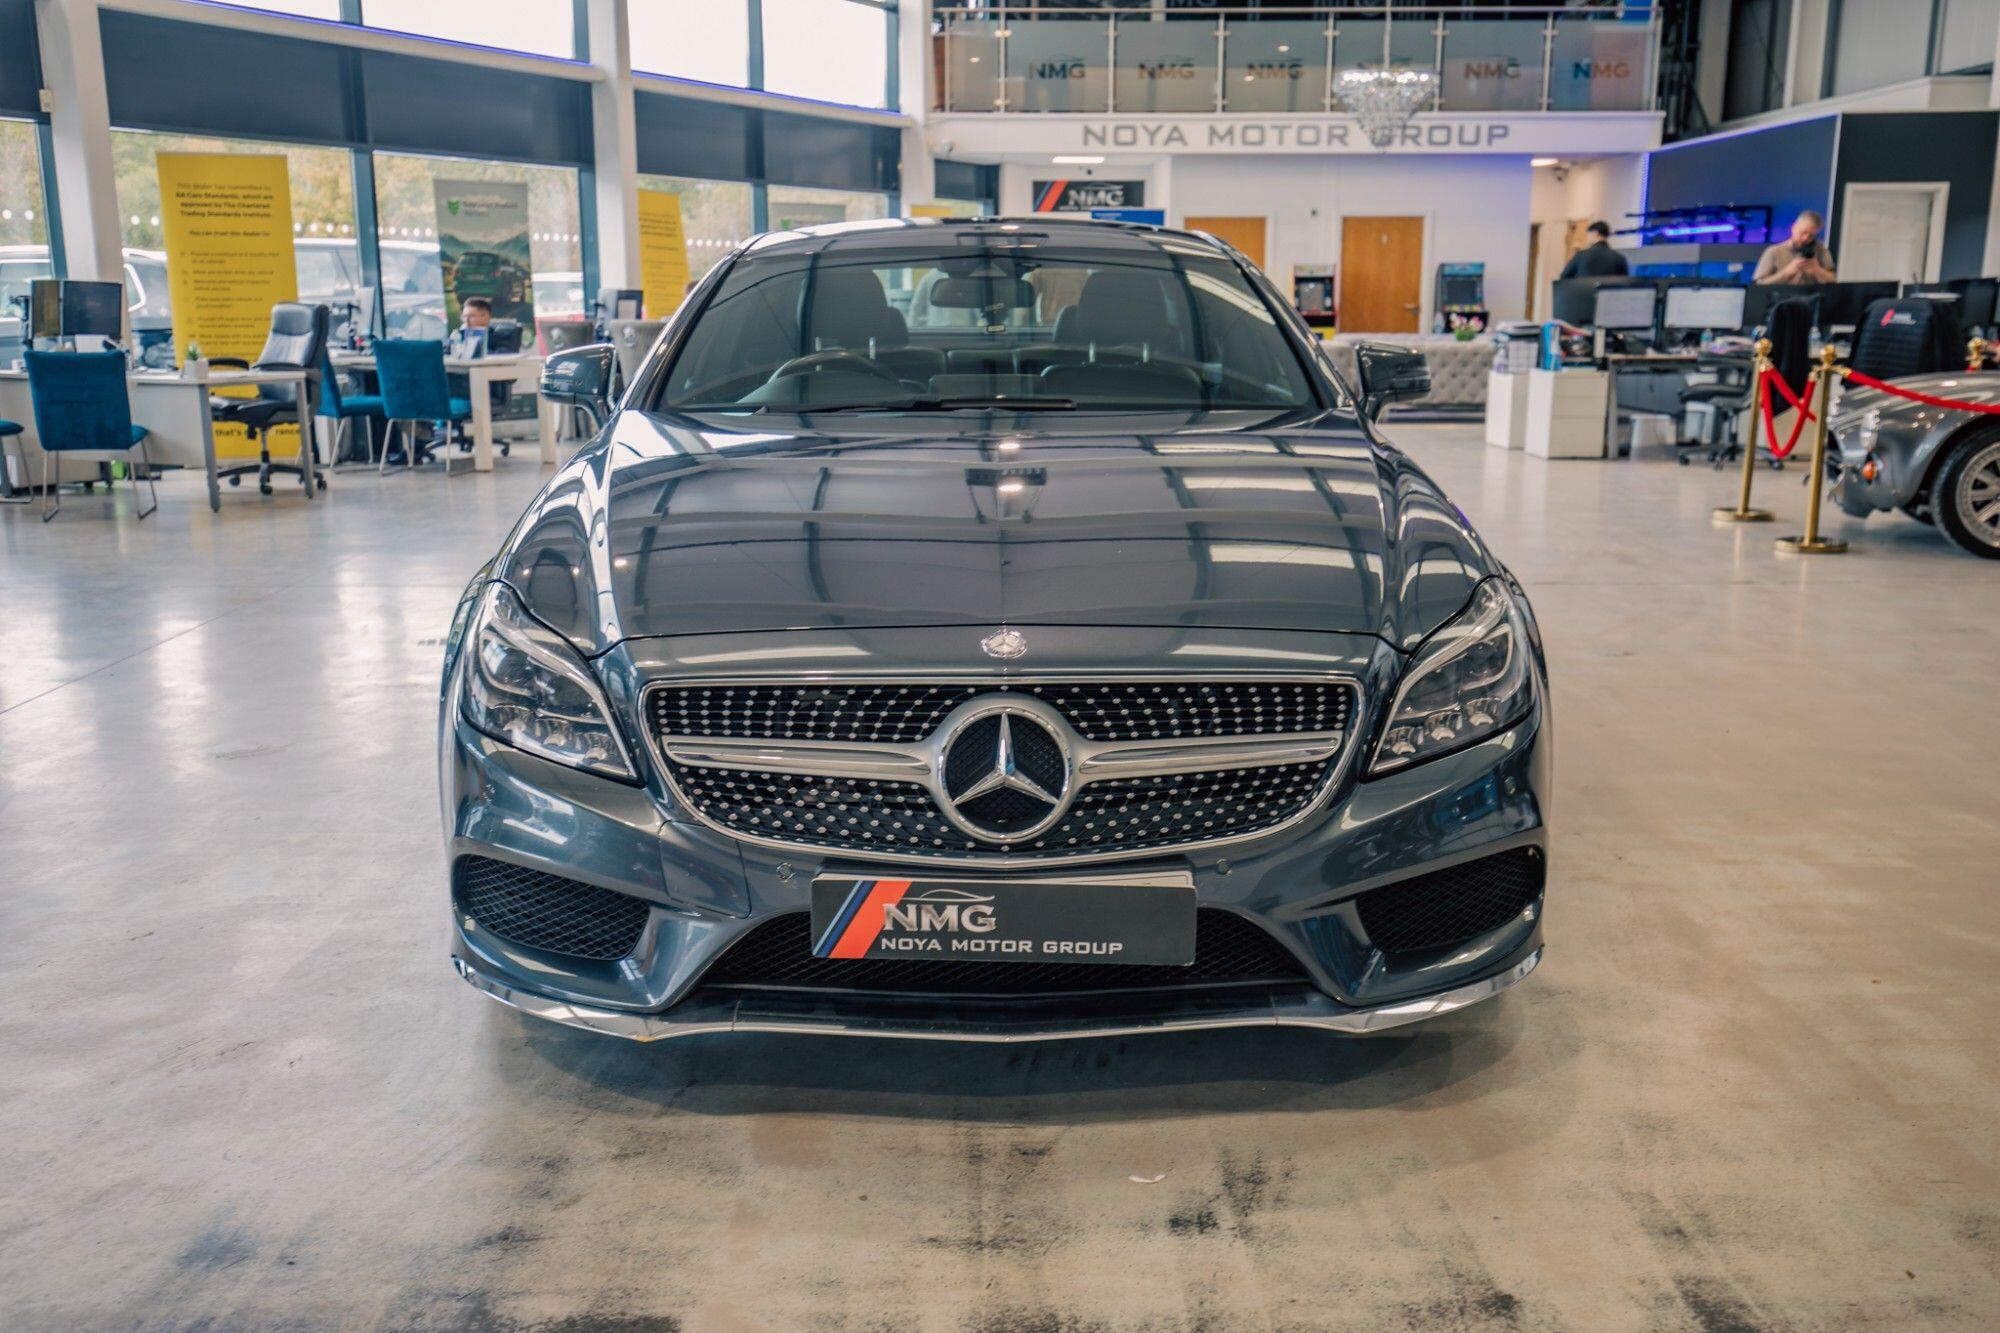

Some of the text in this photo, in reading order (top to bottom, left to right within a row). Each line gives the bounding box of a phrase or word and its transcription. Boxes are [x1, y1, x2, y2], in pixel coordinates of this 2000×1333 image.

[1029, 63, 1086, 79] NMG
[1138, 63, 1195, 79] NMG
[1246, 63, 1304, 79] NMG
[1573, 62, 1630, 79] NMG
[1083, 124, 1188, 146] NOYA
[1208, 124, 1349, 147] MOTOR
[882, 903, 997, 933] NMG
[881, 938, 1123, 955] NOYA MOTOR GROUP
